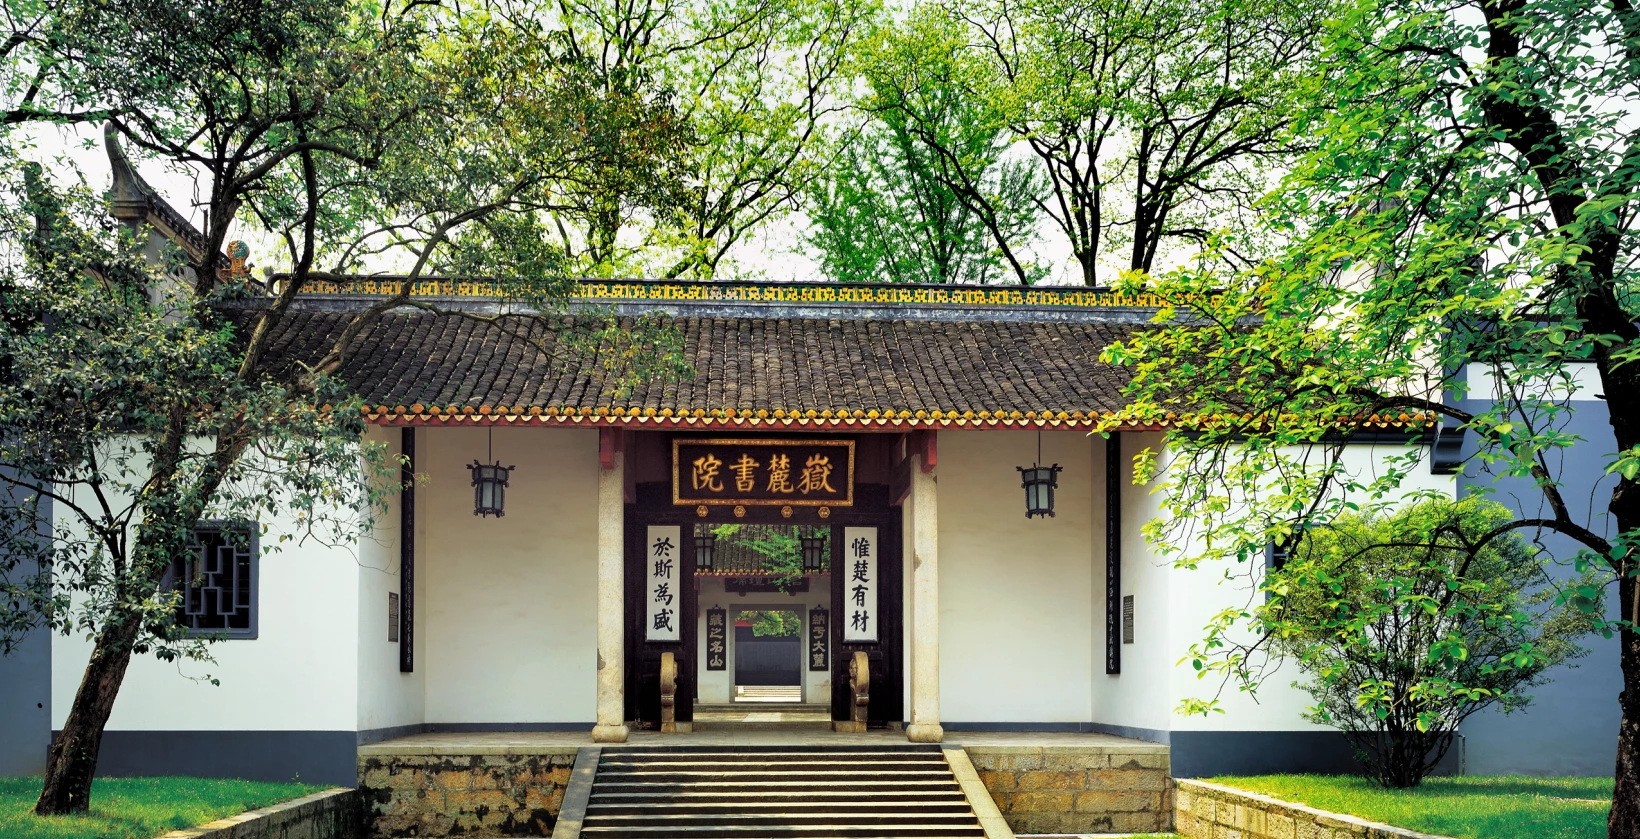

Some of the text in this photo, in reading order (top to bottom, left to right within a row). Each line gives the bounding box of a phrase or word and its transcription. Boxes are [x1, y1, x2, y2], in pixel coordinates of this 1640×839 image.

[692, 453, 837, 494] 嶽麓書院
[653, 537, 675, 632] 於斯為盛
[851, 537, 870, 633] 惟楚有材
[709, 613, 723, 667] 藏之名山
